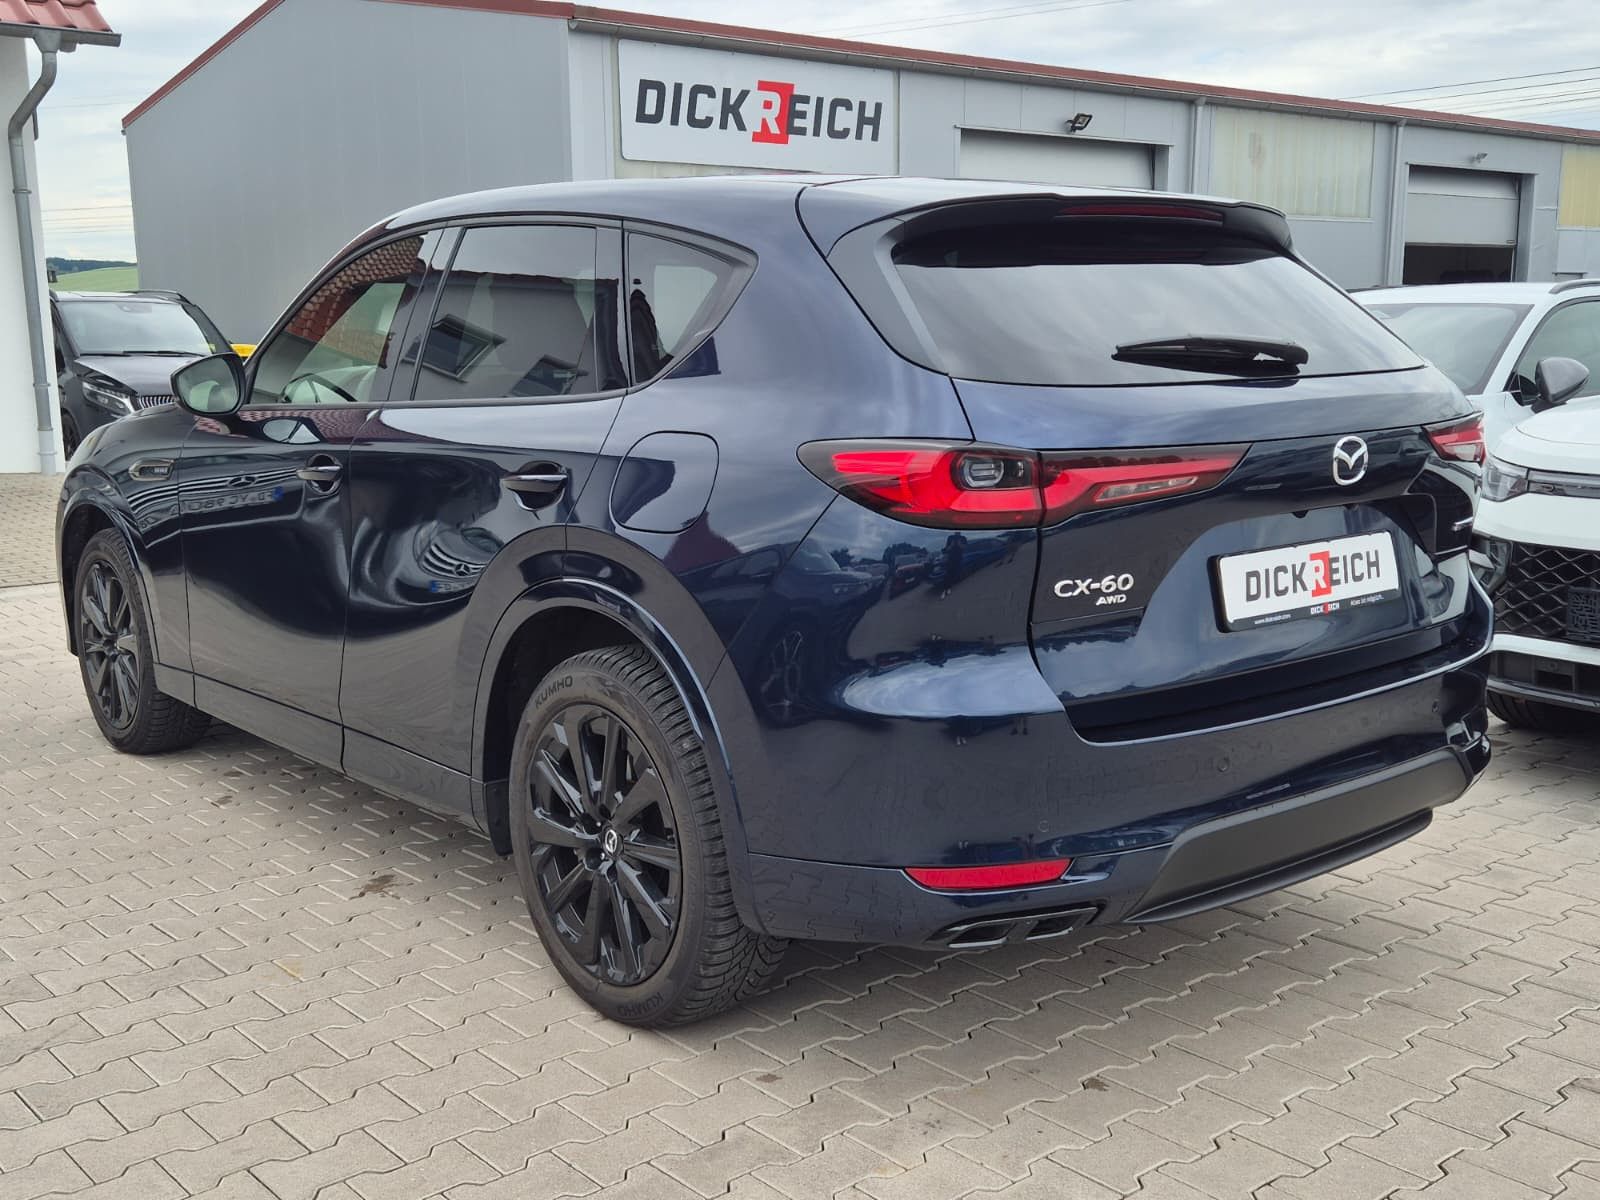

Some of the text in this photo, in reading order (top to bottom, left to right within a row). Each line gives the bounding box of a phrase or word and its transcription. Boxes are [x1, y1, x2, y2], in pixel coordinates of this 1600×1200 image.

[635, 79, 883, 144] DICKREICH
[1054, 573, 1134, 597] CX-60
[1245, 549, 1381, 603] DICKREICH
[1095, 594, 1127, 606] AWD
[535, 675, 573, 709] KUMHO
